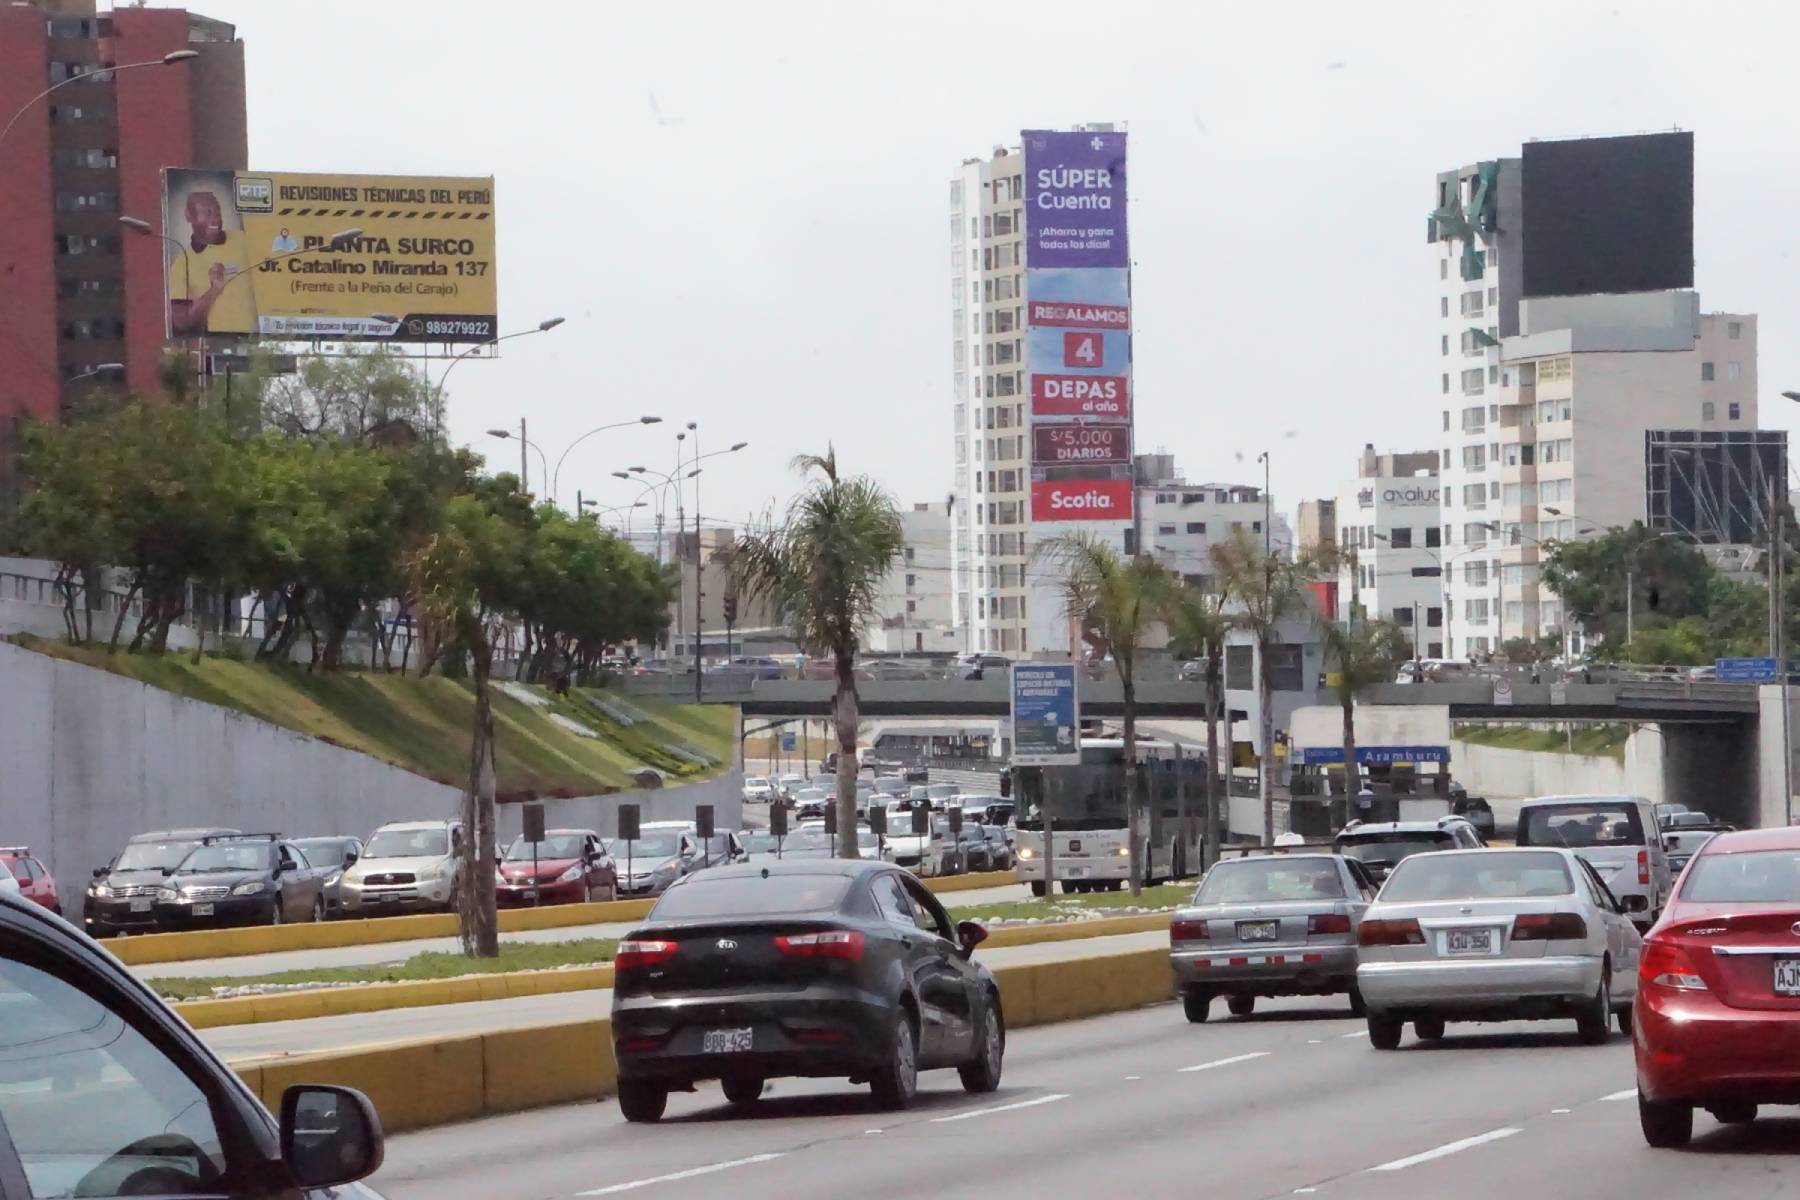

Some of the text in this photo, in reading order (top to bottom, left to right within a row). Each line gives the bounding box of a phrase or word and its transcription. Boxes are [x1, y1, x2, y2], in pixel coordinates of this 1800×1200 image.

[1037, 165, 1112, 189] SÚPER
[280, 185, 490, 205] REVISIONES TÉCNICAS DEL PERÚ
[1038, 192, 1111, 210] Cuenta
[1079, 229, 1086, 238] y
[1087, 229, 1114, 238] gana
[304, 235, 474, 255] PLNTA SURCO
[1040, 240, 1068, 249] todos
[1070, 240, 1084, 249] los
[259, 258, 488, 276] Jr. Catalino Miranda 137
[291, 280, 459, 297] (Frente a la Peña del Carajo)
[1035, 306, 1127, 323] REGALAMOS
[426, 321, 489, 335] 989279922
[1075, 338, 1095, 362] 4
[1044, 380, 1117, 399] DEPAS
[1082, 400, 1118, 412] al año
[1057, 447, 1112, 459] DIARIOS
[1051, 490, 1110, 508] Scotia
